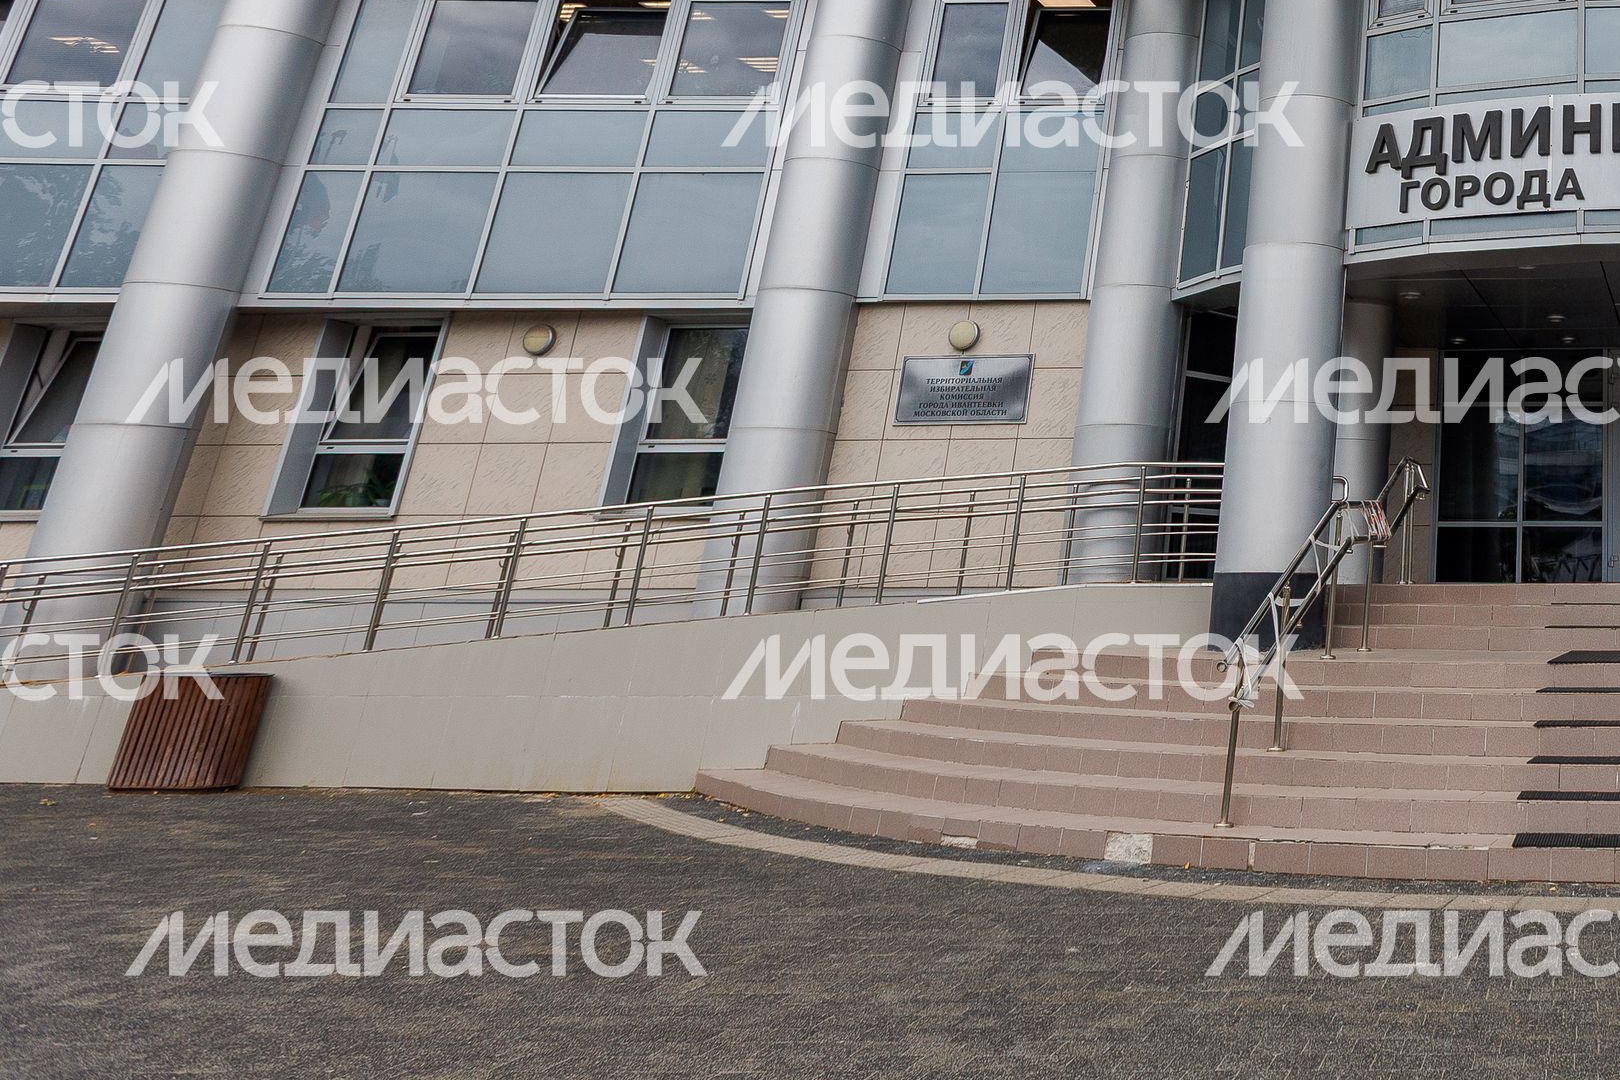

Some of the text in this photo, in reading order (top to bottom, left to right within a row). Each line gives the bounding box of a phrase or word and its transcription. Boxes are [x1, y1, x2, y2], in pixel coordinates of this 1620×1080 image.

[1399, 167, 1585, 213] ГОРОДА
[926, 377, 1003, 385] ТЕРРИТОРИАЛЬНАЯ
[929, 385, 997, 393] ИЗБИРАТЕЛЬНАЯ
[939, 393, 985, 401] КОМИССИЯ
[951, 401, 1004, 409] ИВАНТЕЕВКИ
[912, 409, 1007, 417] МОСКОВСКОЙ ОБЛАСТИ
